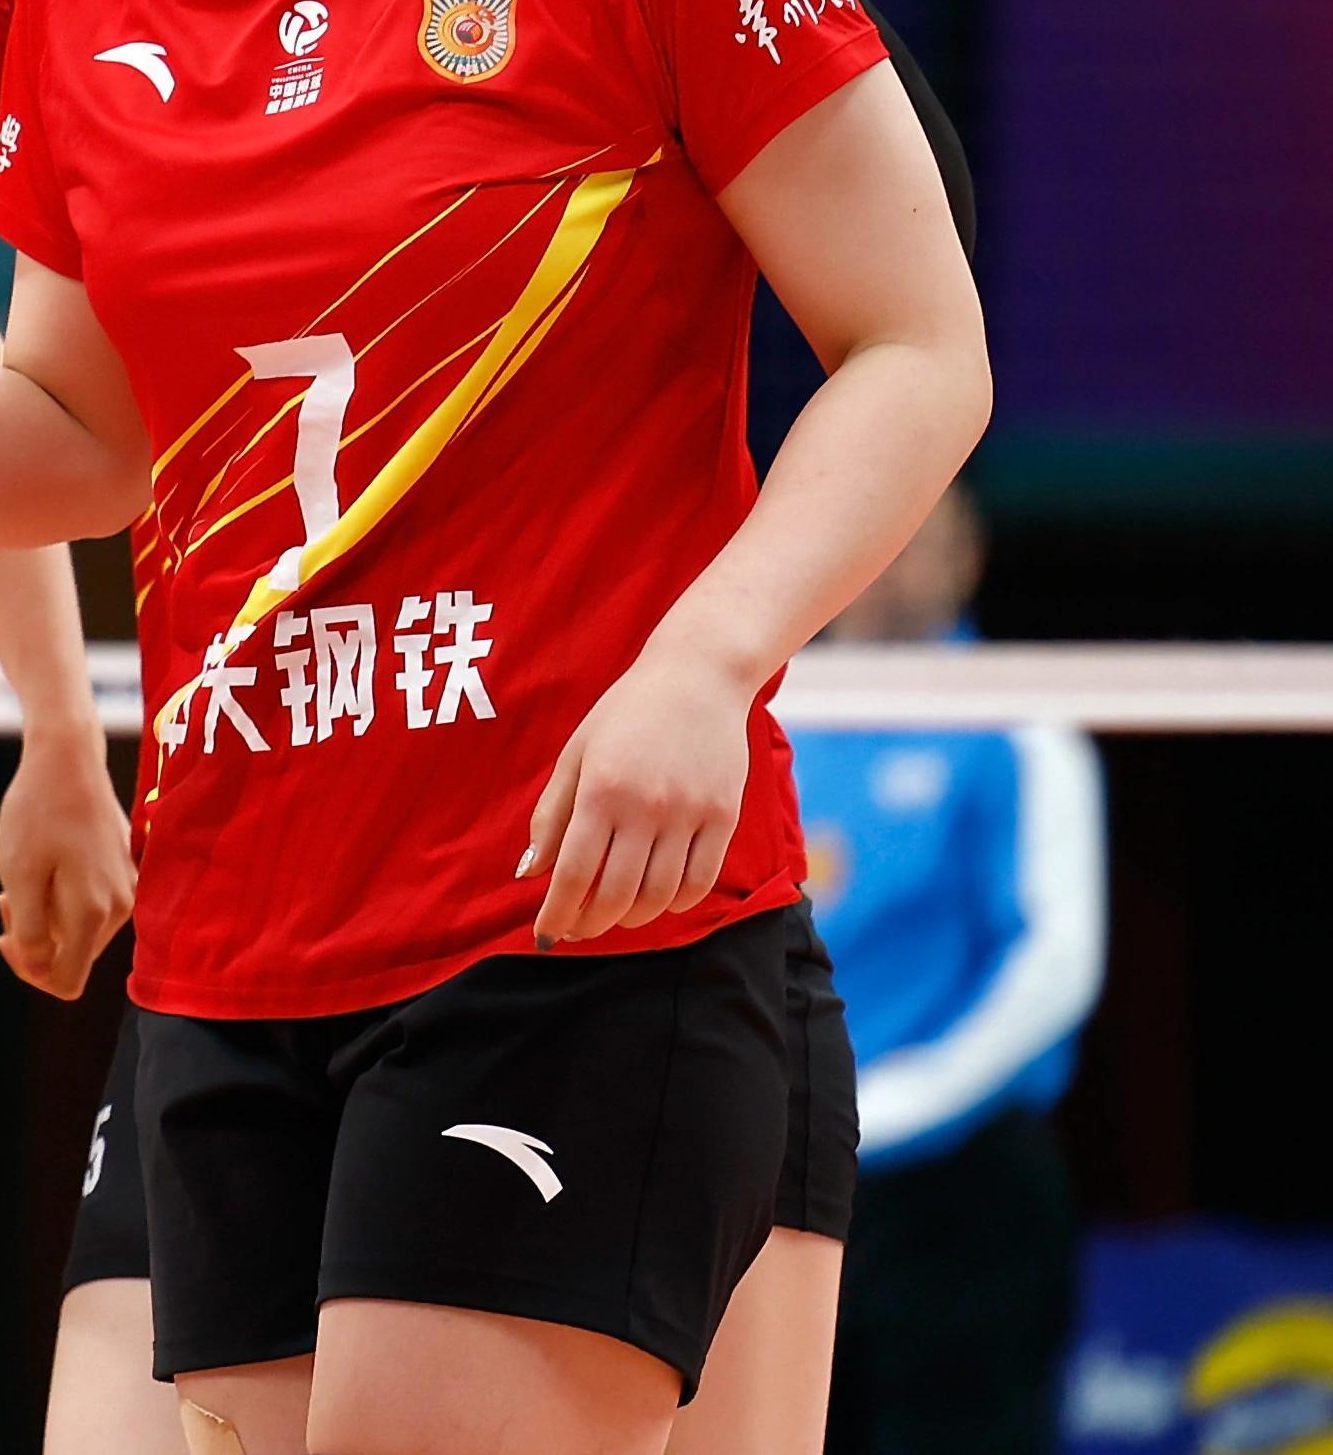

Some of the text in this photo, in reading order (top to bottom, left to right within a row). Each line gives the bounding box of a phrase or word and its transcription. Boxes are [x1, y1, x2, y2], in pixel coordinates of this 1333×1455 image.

[235, 332, 356, 592] 7
[158, 590, 497, 758] 天钢铁
